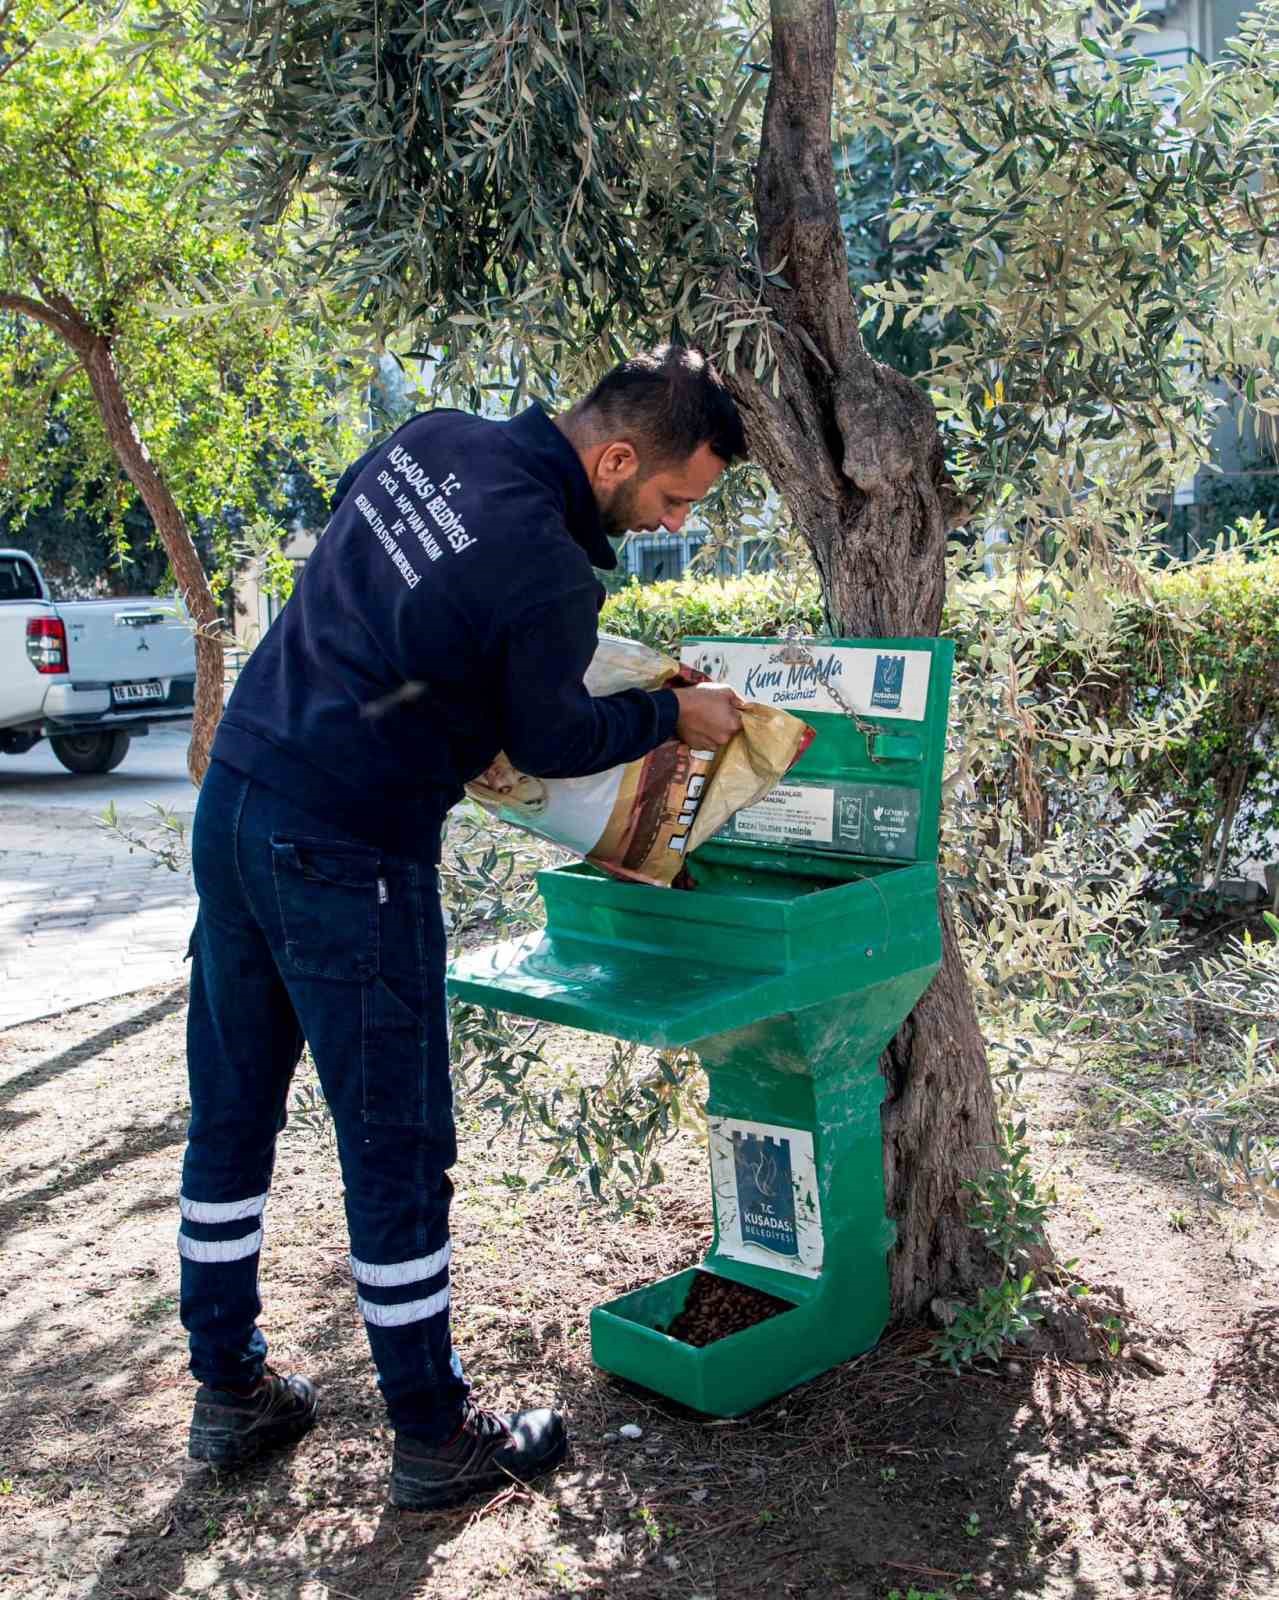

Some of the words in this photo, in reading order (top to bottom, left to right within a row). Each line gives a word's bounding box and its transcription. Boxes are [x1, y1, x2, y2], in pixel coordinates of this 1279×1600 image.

[377, 470, 400, 497] EVCİL
[417, 528, 444, 562] BAKIM
[387, 445, 436, 500] KUŞADASI
[425, 495, 478, 554] BELEDİYESİ
[390, 519, 407, 537] VE
[745, 664, 784, 698] Kuru
